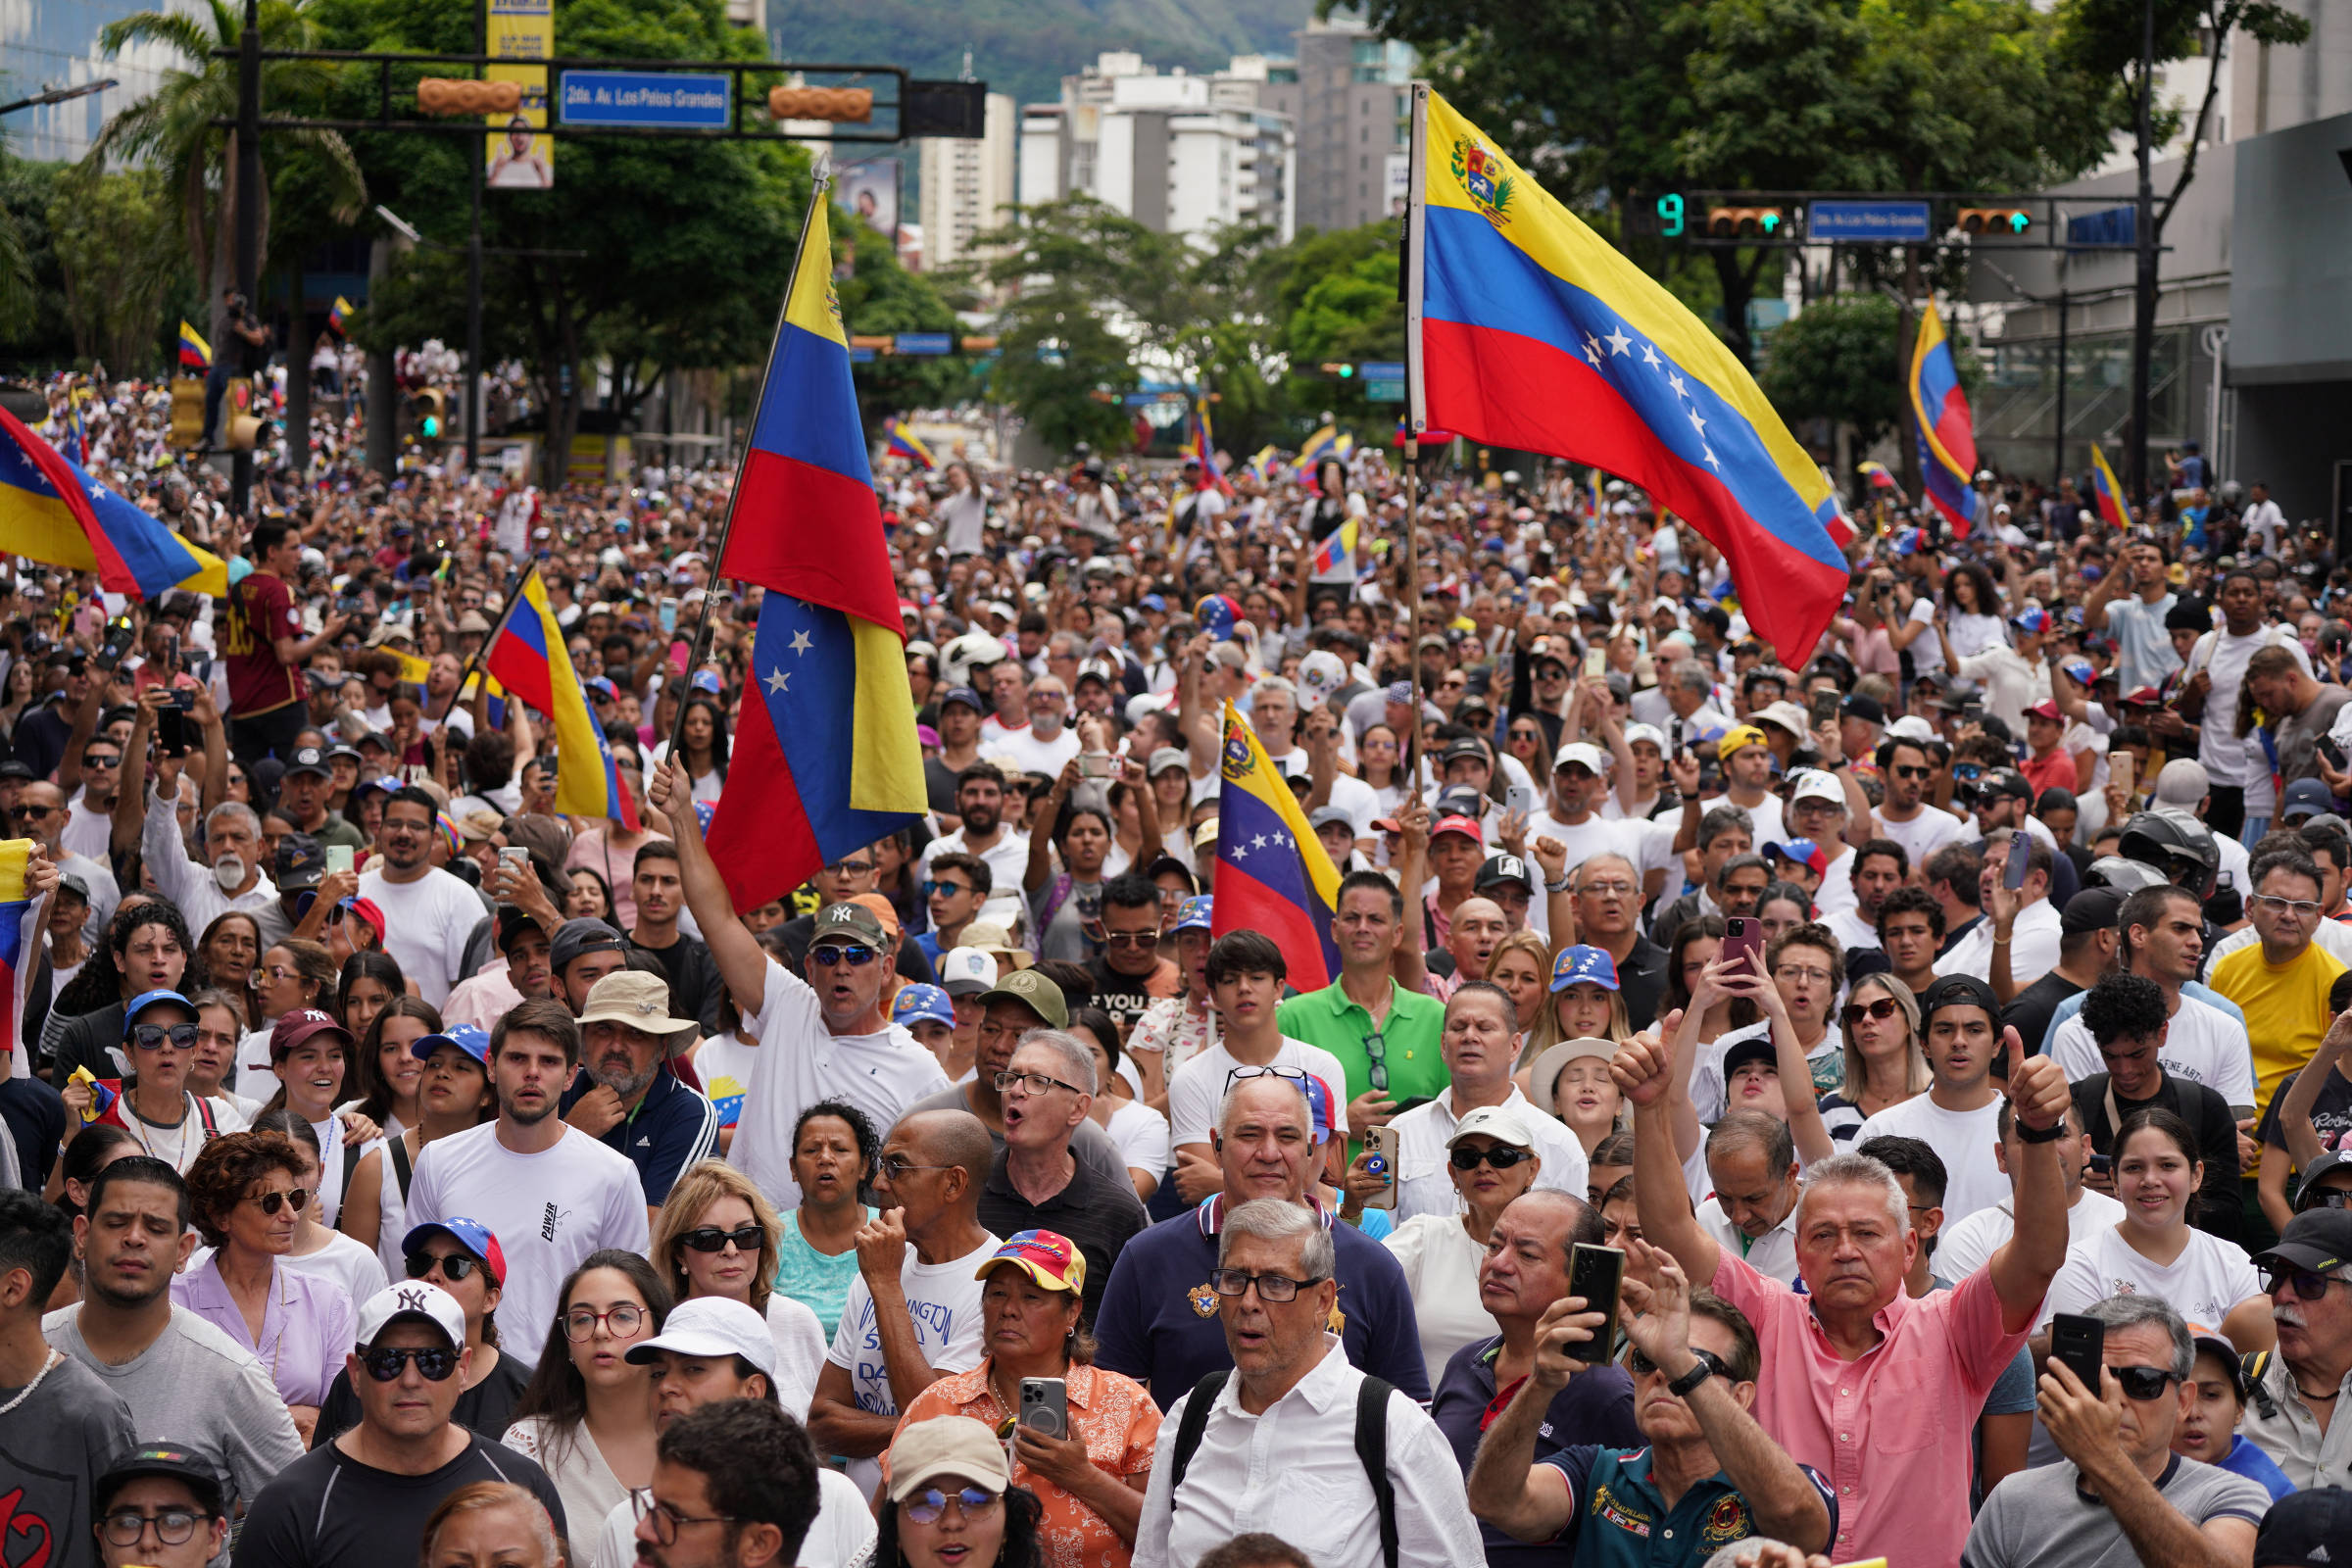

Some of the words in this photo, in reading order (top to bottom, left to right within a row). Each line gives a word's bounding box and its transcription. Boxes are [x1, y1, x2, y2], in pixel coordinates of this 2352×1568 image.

[595, 86, 612, 106] Av.
[615, 87, 637, 107] Los
[639, 87, 672, 108] Palos
[674, 89, 723, 109] Grandes
[1657, 193, 1684, 236] 9
[832, 906, 853, 921] NY
[1102, 994, 1144, 1010] YOU
[397, 1288, 427, 1312] NY
